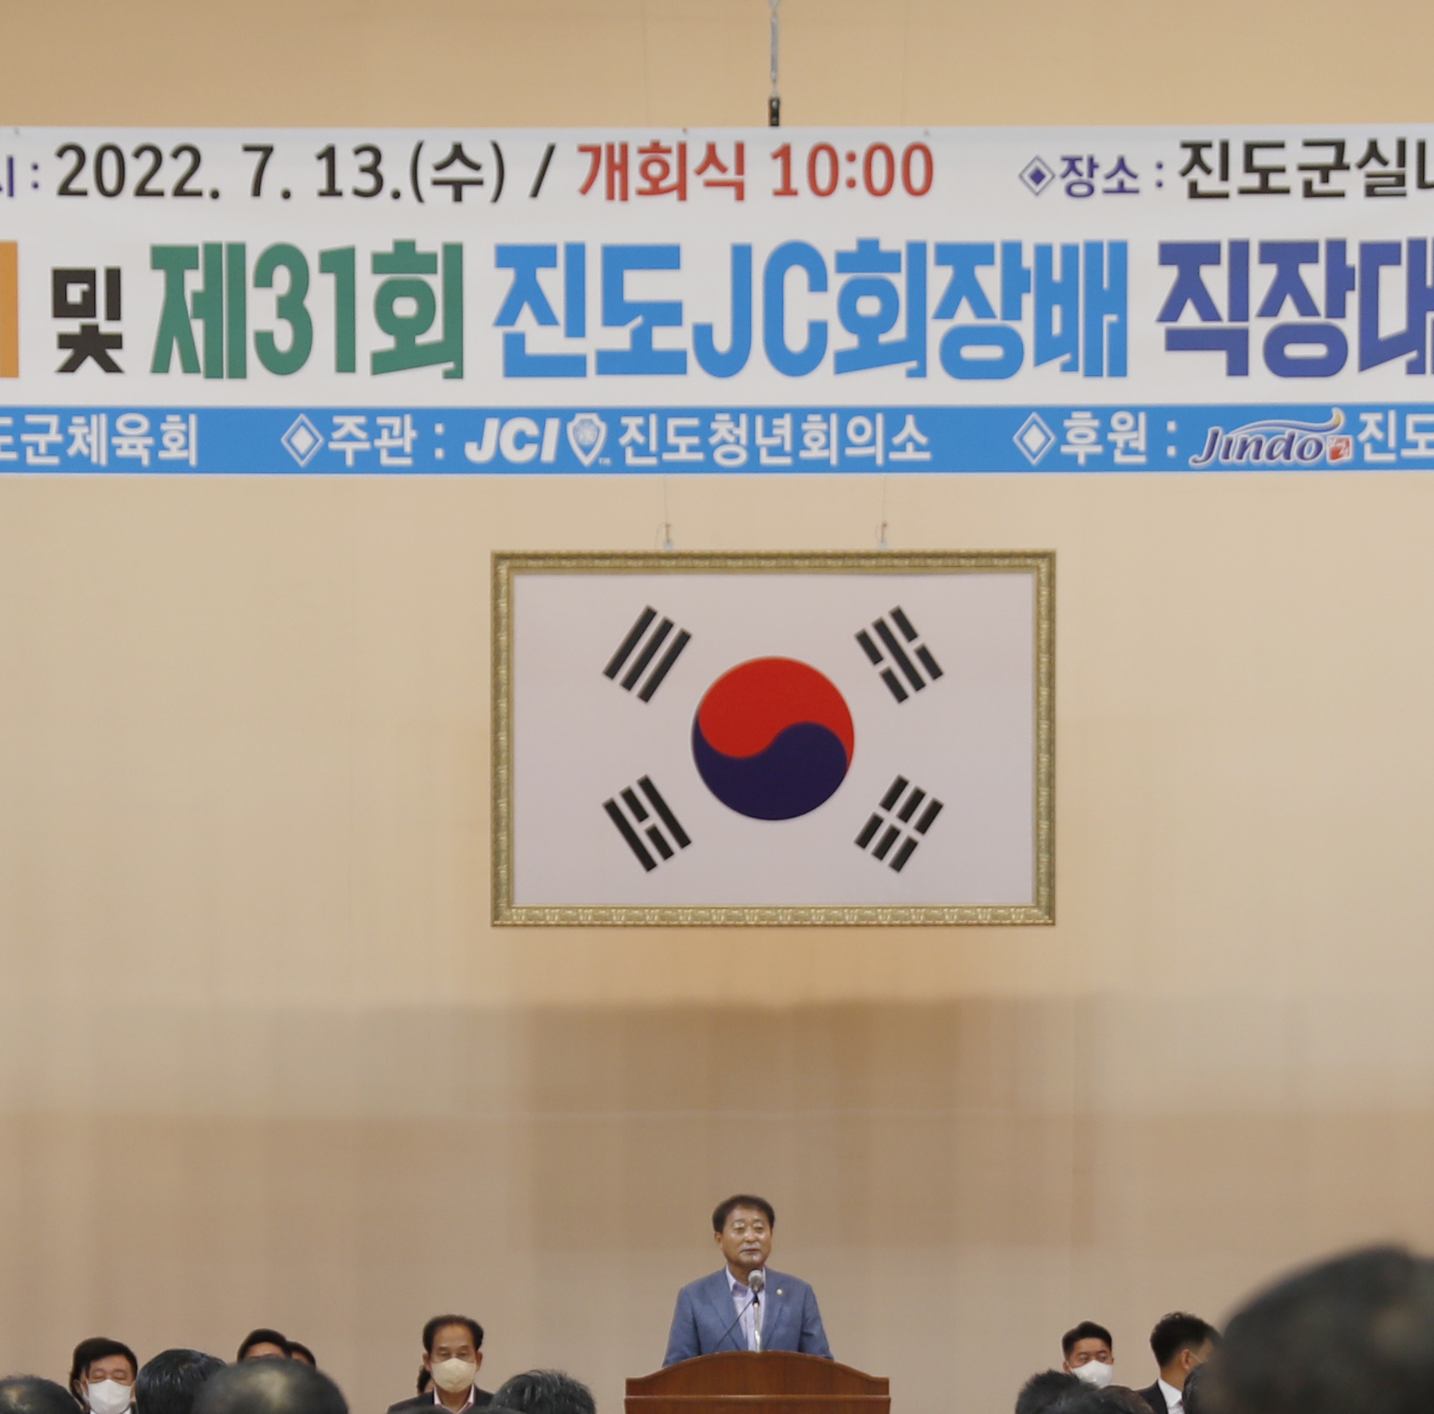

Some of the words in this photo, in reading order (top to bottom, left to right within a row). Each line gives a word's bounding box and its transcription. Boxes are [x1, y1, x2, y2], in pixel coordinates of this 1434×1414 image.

[55, 143, 221, 200] 2022.
[242, 144, 292, 200] 7.
[316, 140, 505, 204] 13.(수)
[577, 141, 746, 202] 개회식
[771, 143, 935, 197] 10:00
[52, 267, 124, 374] 및
[151, 239, 464, 379] 제31회
[494, 238, 1129, 380] 진도JC회장배
[464, 416, 560, 464] JCI
[618, 412, 933, 468] 진도청년회의소
